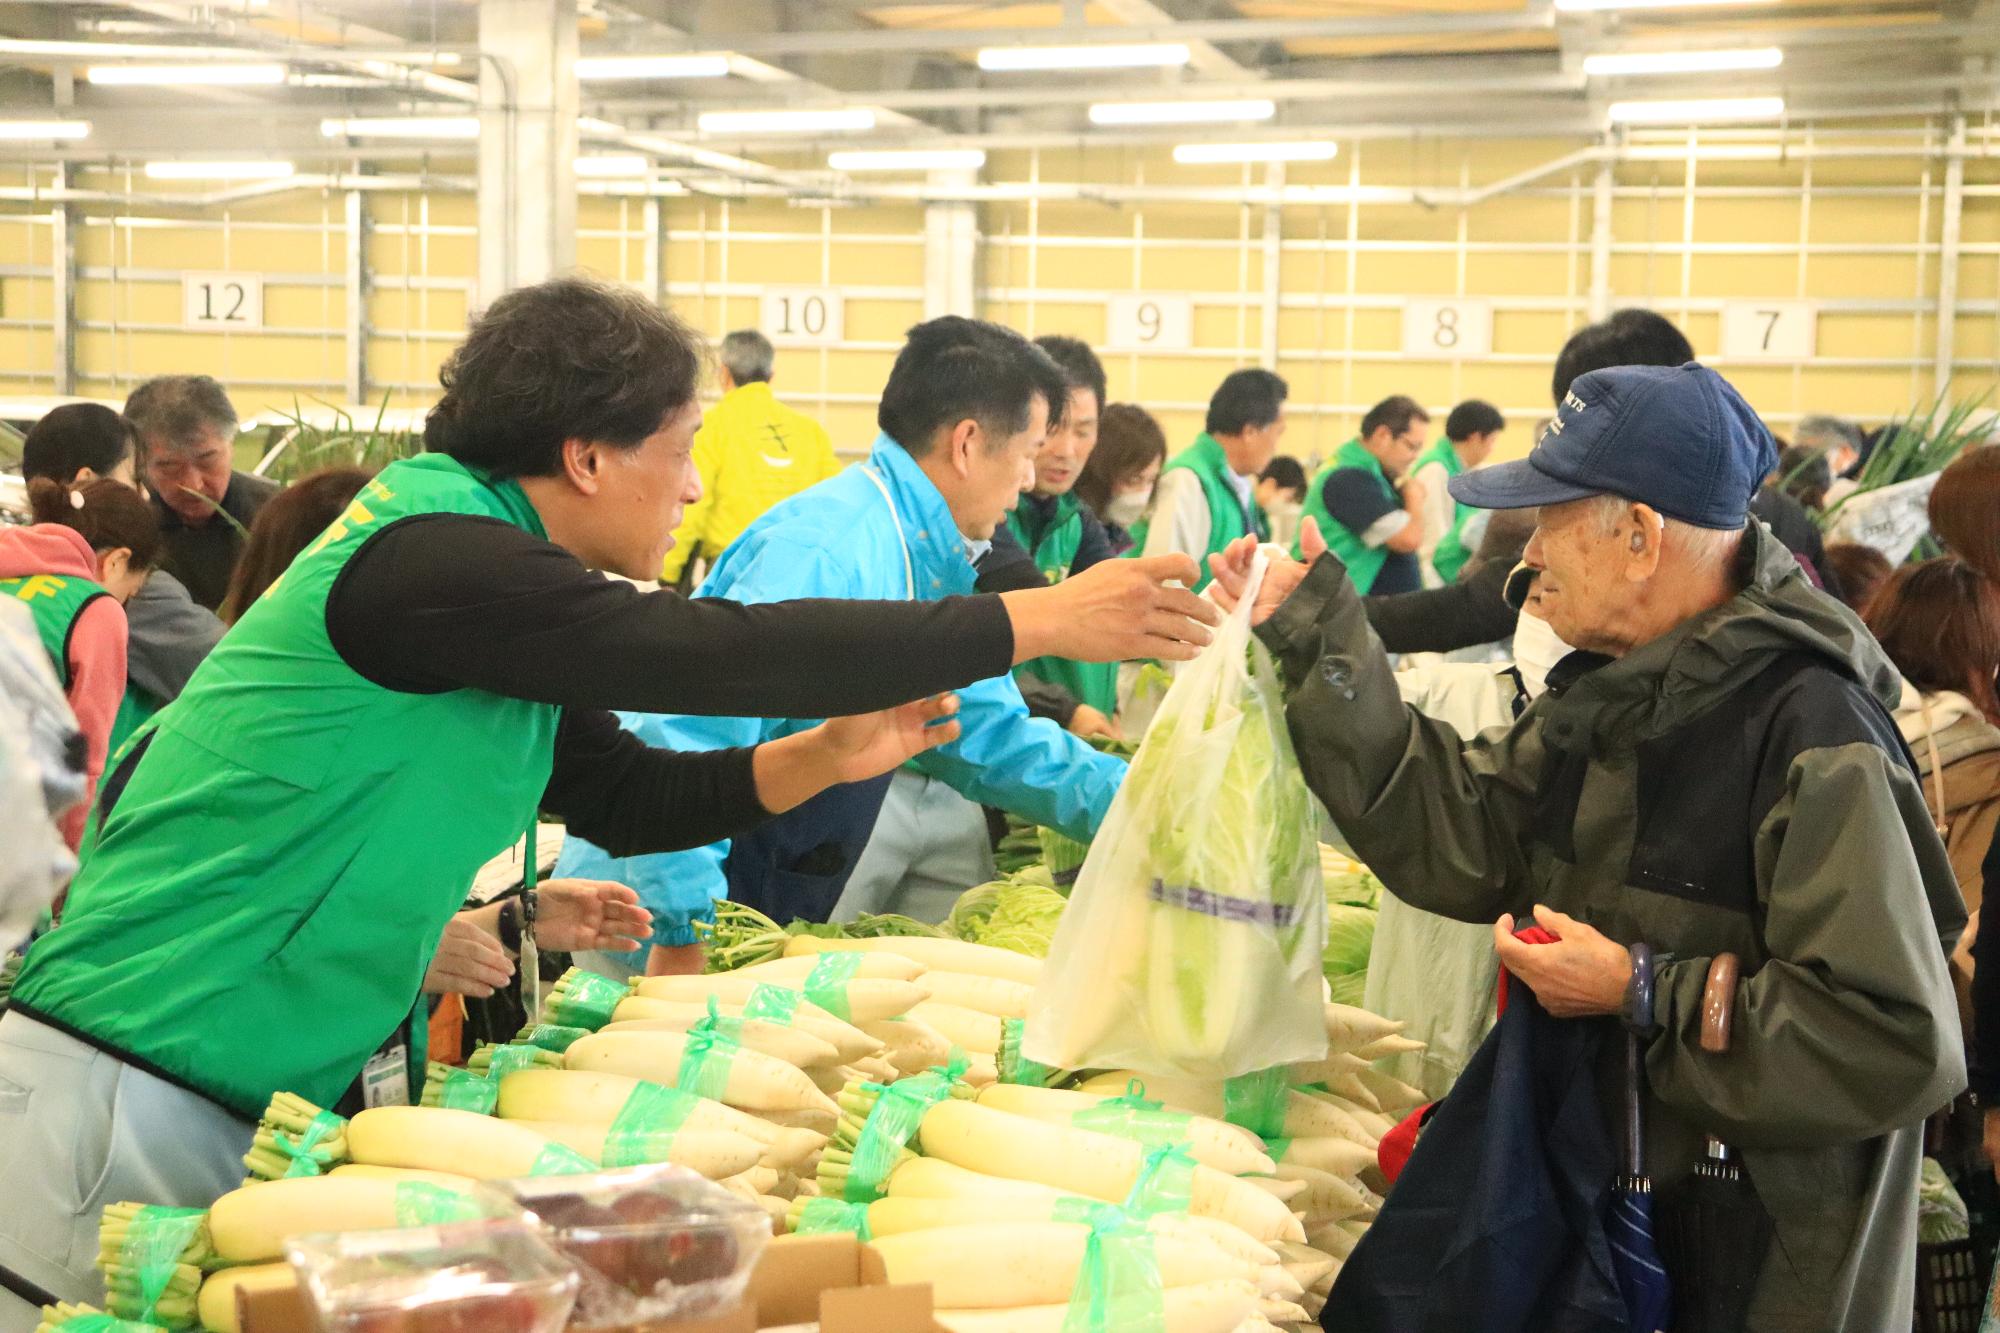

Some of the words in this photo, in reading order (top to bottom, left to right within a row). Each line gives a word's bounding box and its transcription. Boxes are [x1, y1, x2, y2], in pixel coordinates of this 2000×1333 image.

[198, 282, 246, 321] 12
[777, 295, 826, 336] 10
[1137, 302, 1161, 342] 9
[1433, 307, 1458, 348] 8
[1756, 310, 1780, 351] 7
